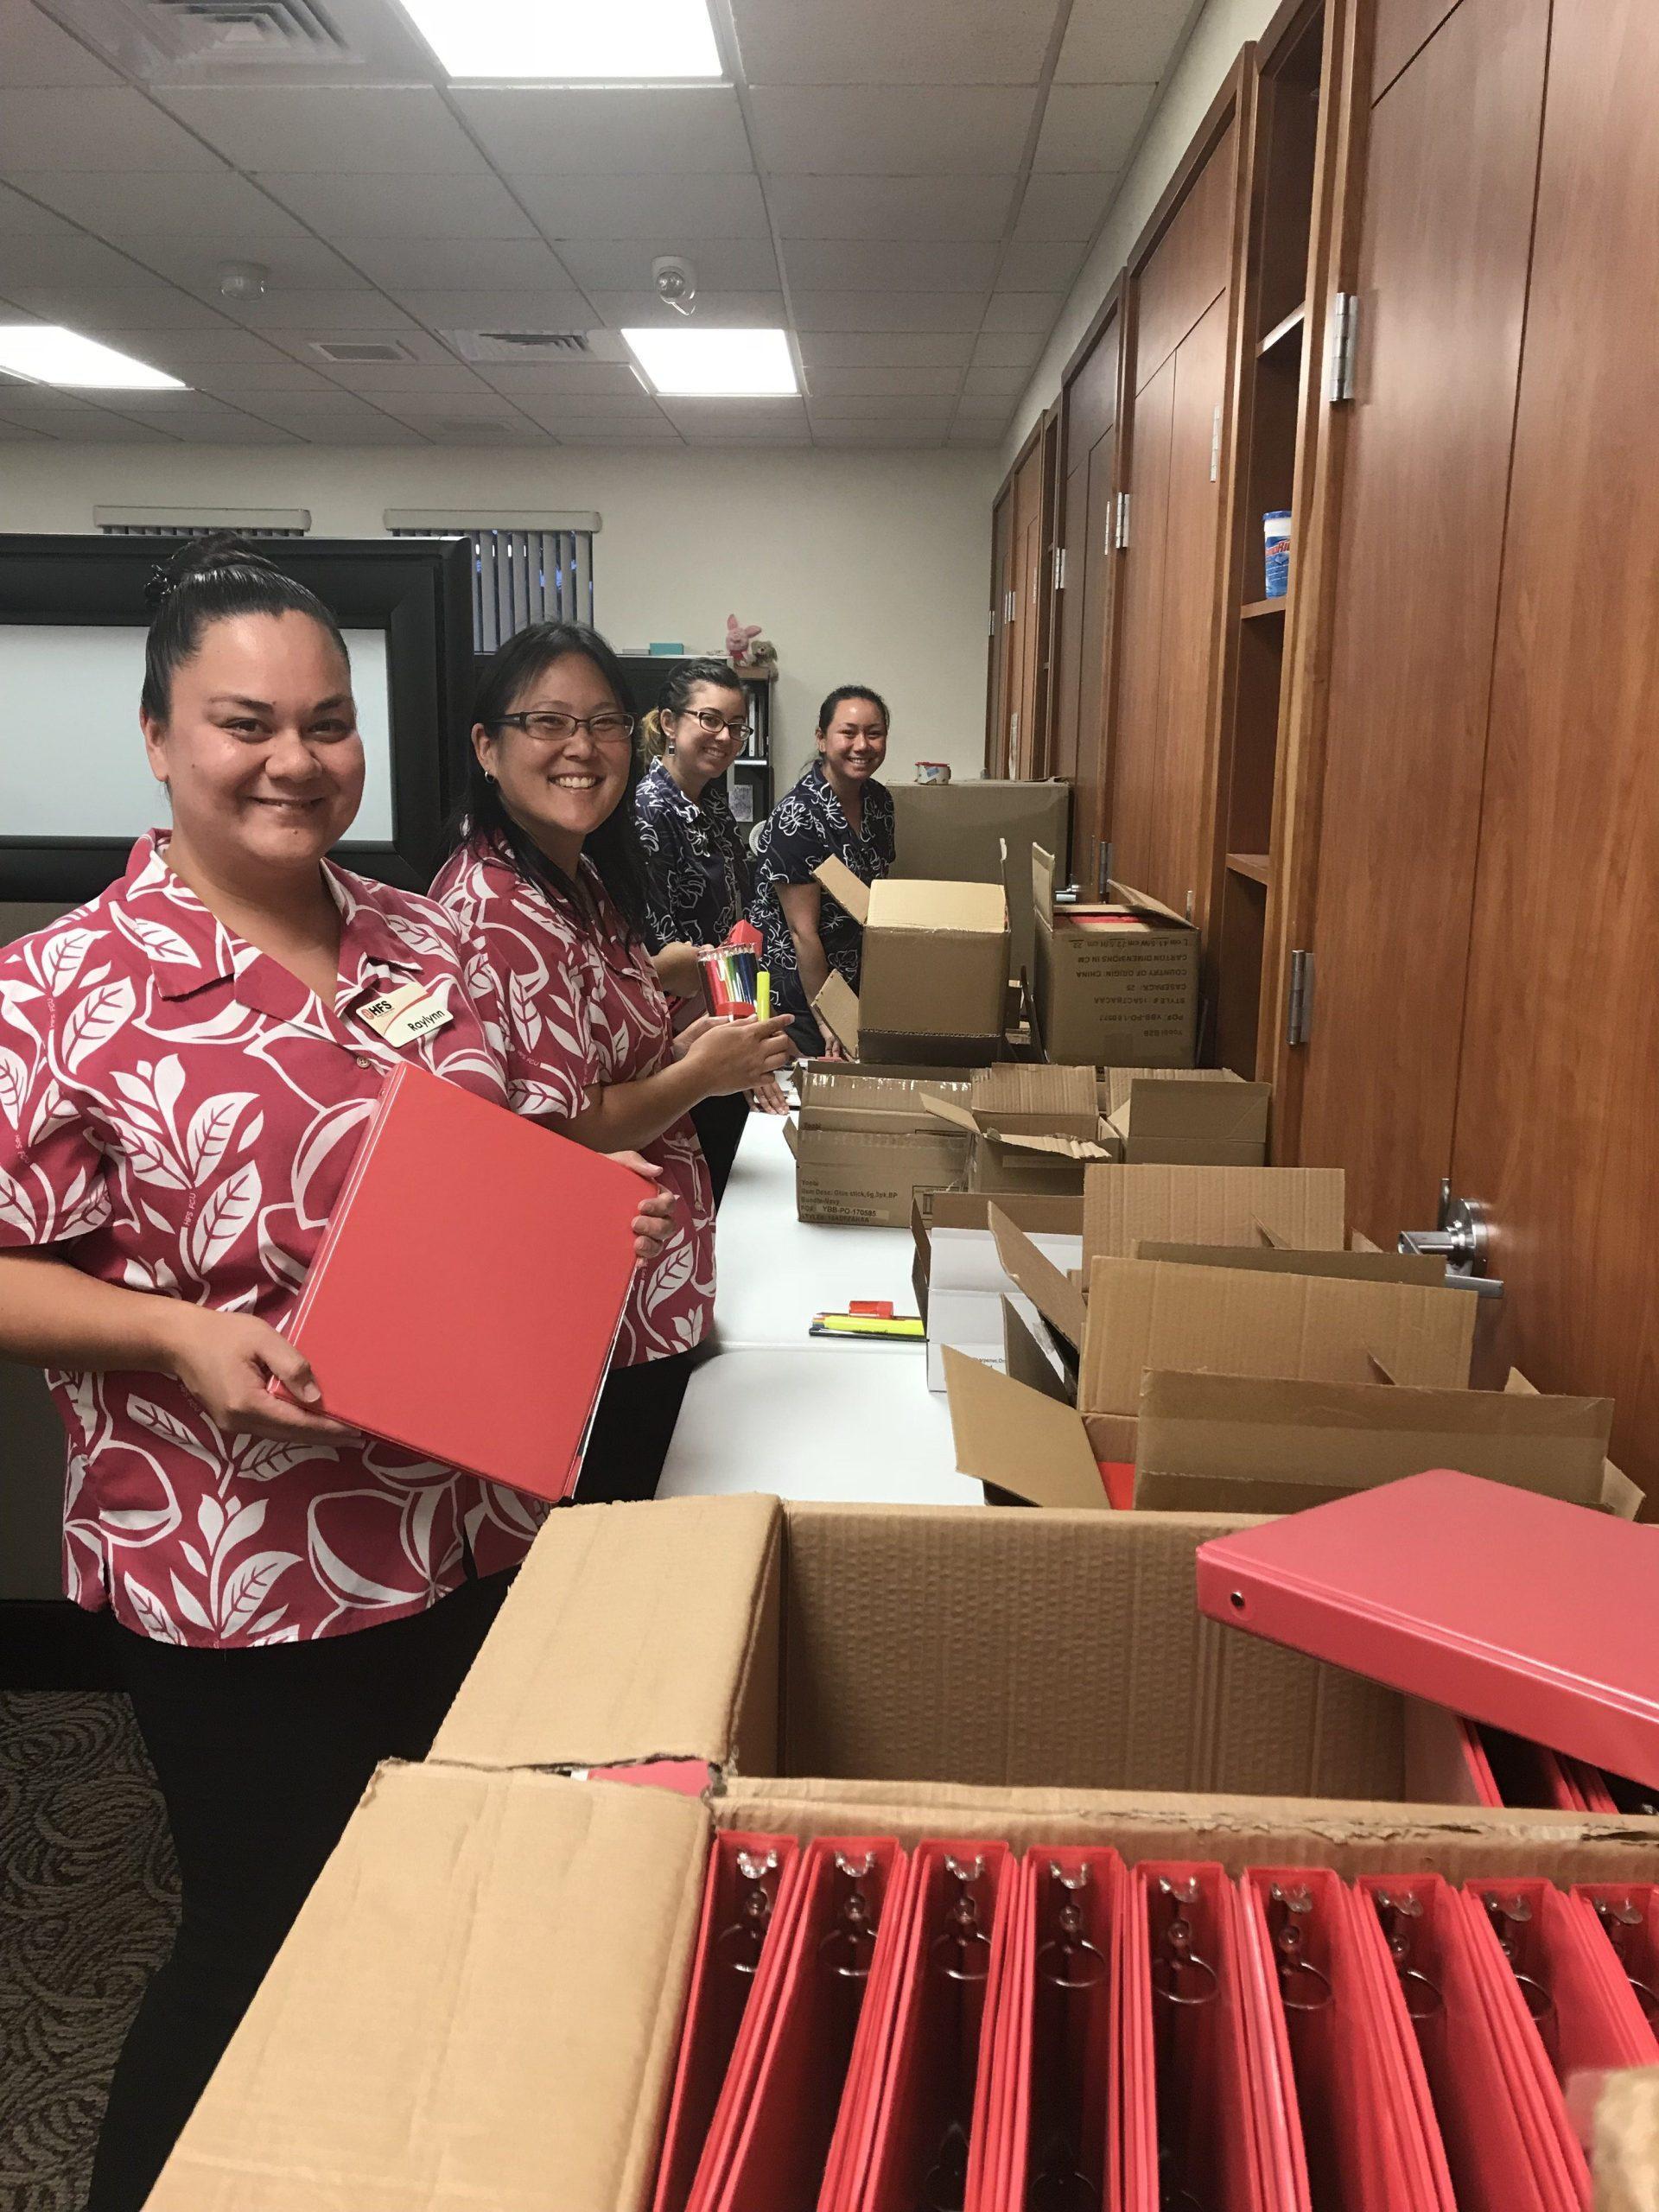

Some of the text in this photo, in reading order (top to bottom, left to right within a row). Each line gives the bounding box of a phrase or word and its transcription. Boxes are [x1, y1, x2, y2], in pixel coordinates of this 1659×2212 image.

[368, 1001, 392, 1016] HFS
[407, 1009, 446, 1032] Raylynn
[183, 1211, 194, 1227] HFS
